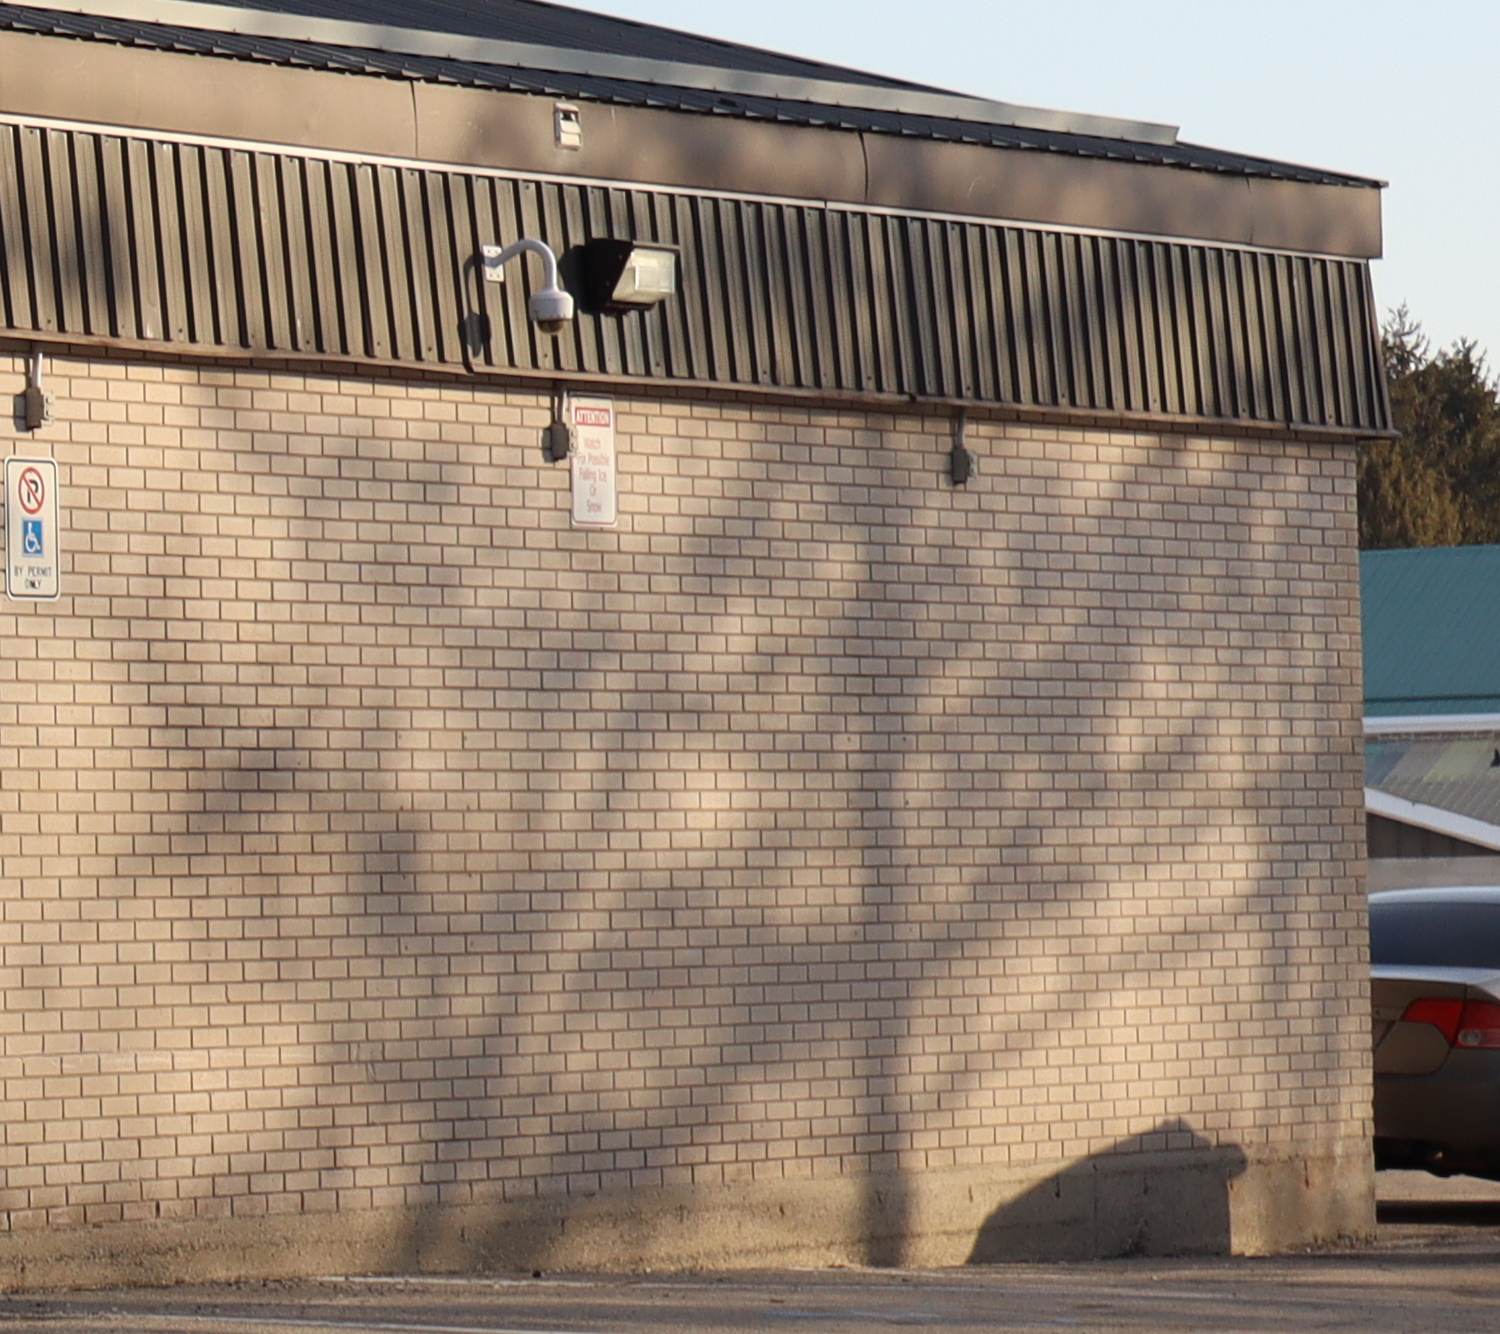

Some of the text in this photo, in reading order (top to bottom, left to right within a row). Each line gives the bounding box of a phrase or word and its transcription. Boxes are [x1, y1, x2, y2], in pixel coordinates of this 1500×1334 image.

[14, 566, 52, 578] BY PERMIT
[25, 578, 42, 590] ONLY
